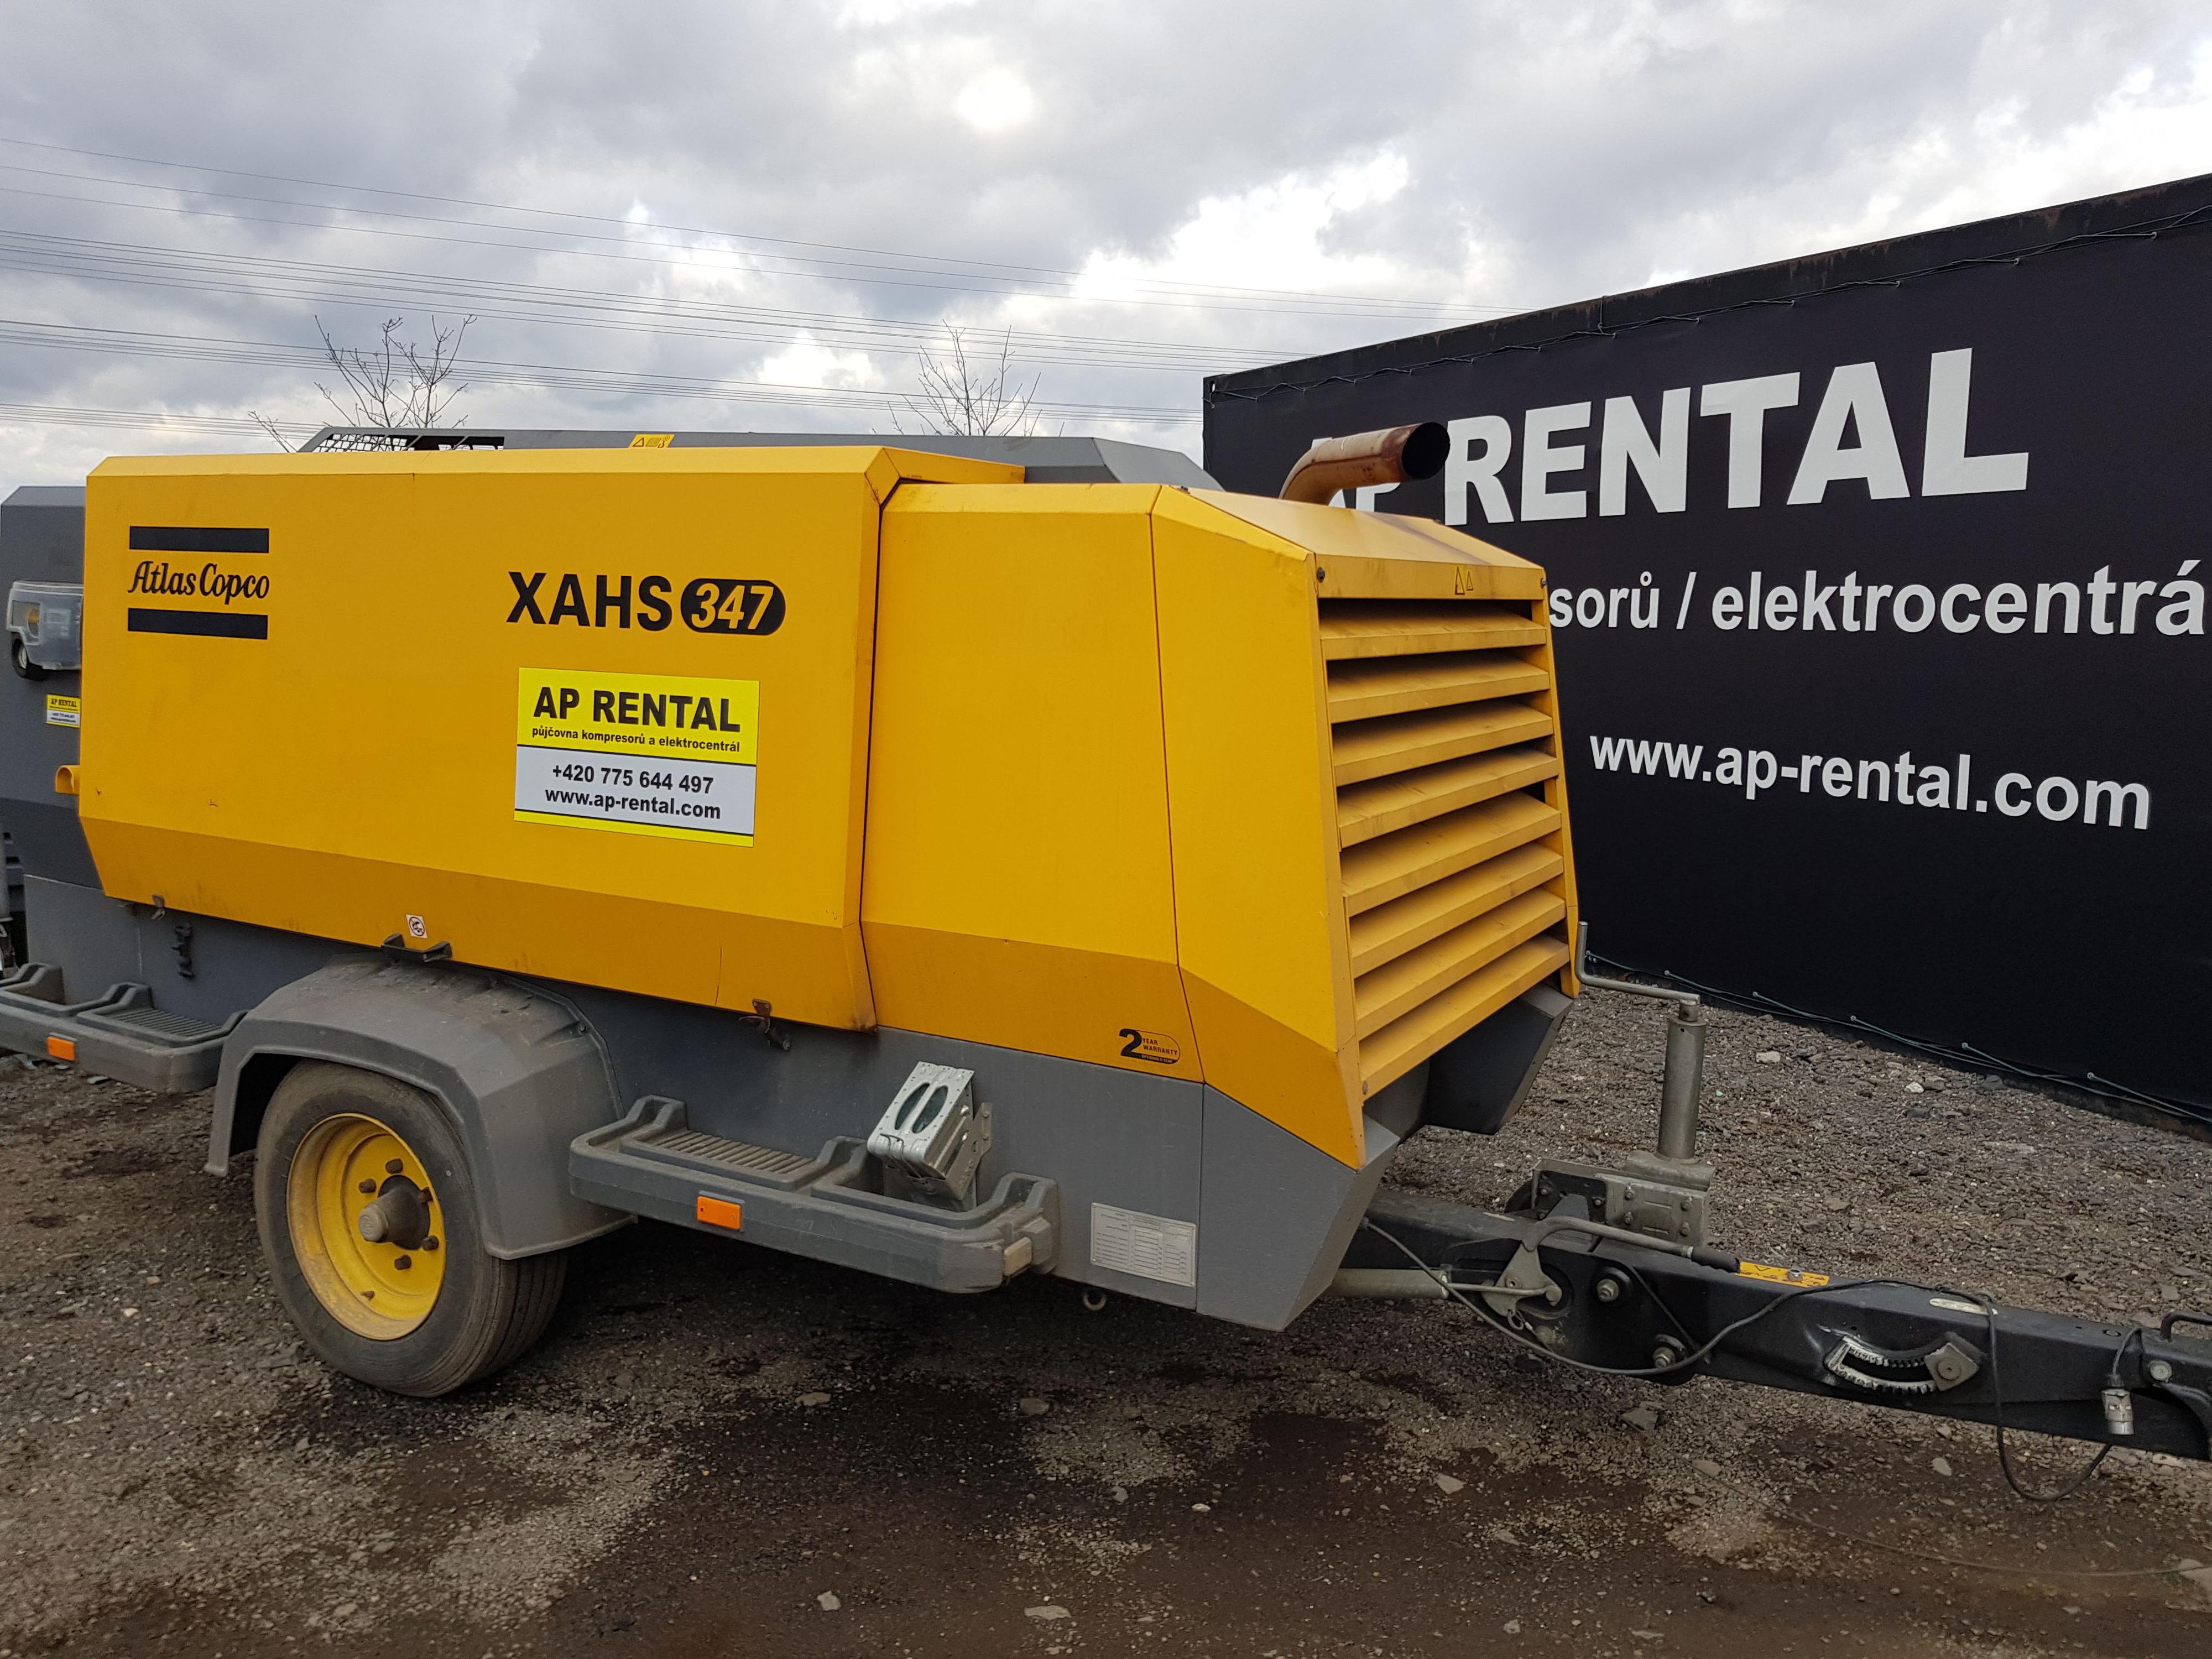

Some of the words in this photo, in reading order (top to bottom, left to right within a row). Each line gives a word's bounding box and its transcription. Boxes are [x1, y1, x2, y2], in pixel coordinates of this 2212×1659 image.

[1444, 347, 2030, 526] RENTAL
[127, 561, 196, 596] Atlas
[199, 562, 270, 605] Copco
[506, 571, 673, 632] XAHS
[691, 583, 774, 630] 347
[1676, 572, 1697, 630] /
[1712, 559, 2205, 635] elektrocentrá
[533, 686, 580, 719] AP
[593, 690, 741, 733] RENTAL
[532, 724, 578, 742] půjčovna
[582, 729, 646, 745] kompresorů
[649, 737, 655, 745] a
[659, 735, 740, 753] elektrocentrál
[552, 764, 595, 783] +420
[601, 766, 634, 787] 775
[639, 771, 673, 791] 644
[679, 775, 714, 795] 497
[1589, 735, 2151, 831] www.ap-rental.com
[545, 789, 721, 820] www.ap-rental.com
[1119, 1029, 1142, 1057] 2
[1143, 1045, 1177, 1056] WARRANTY
